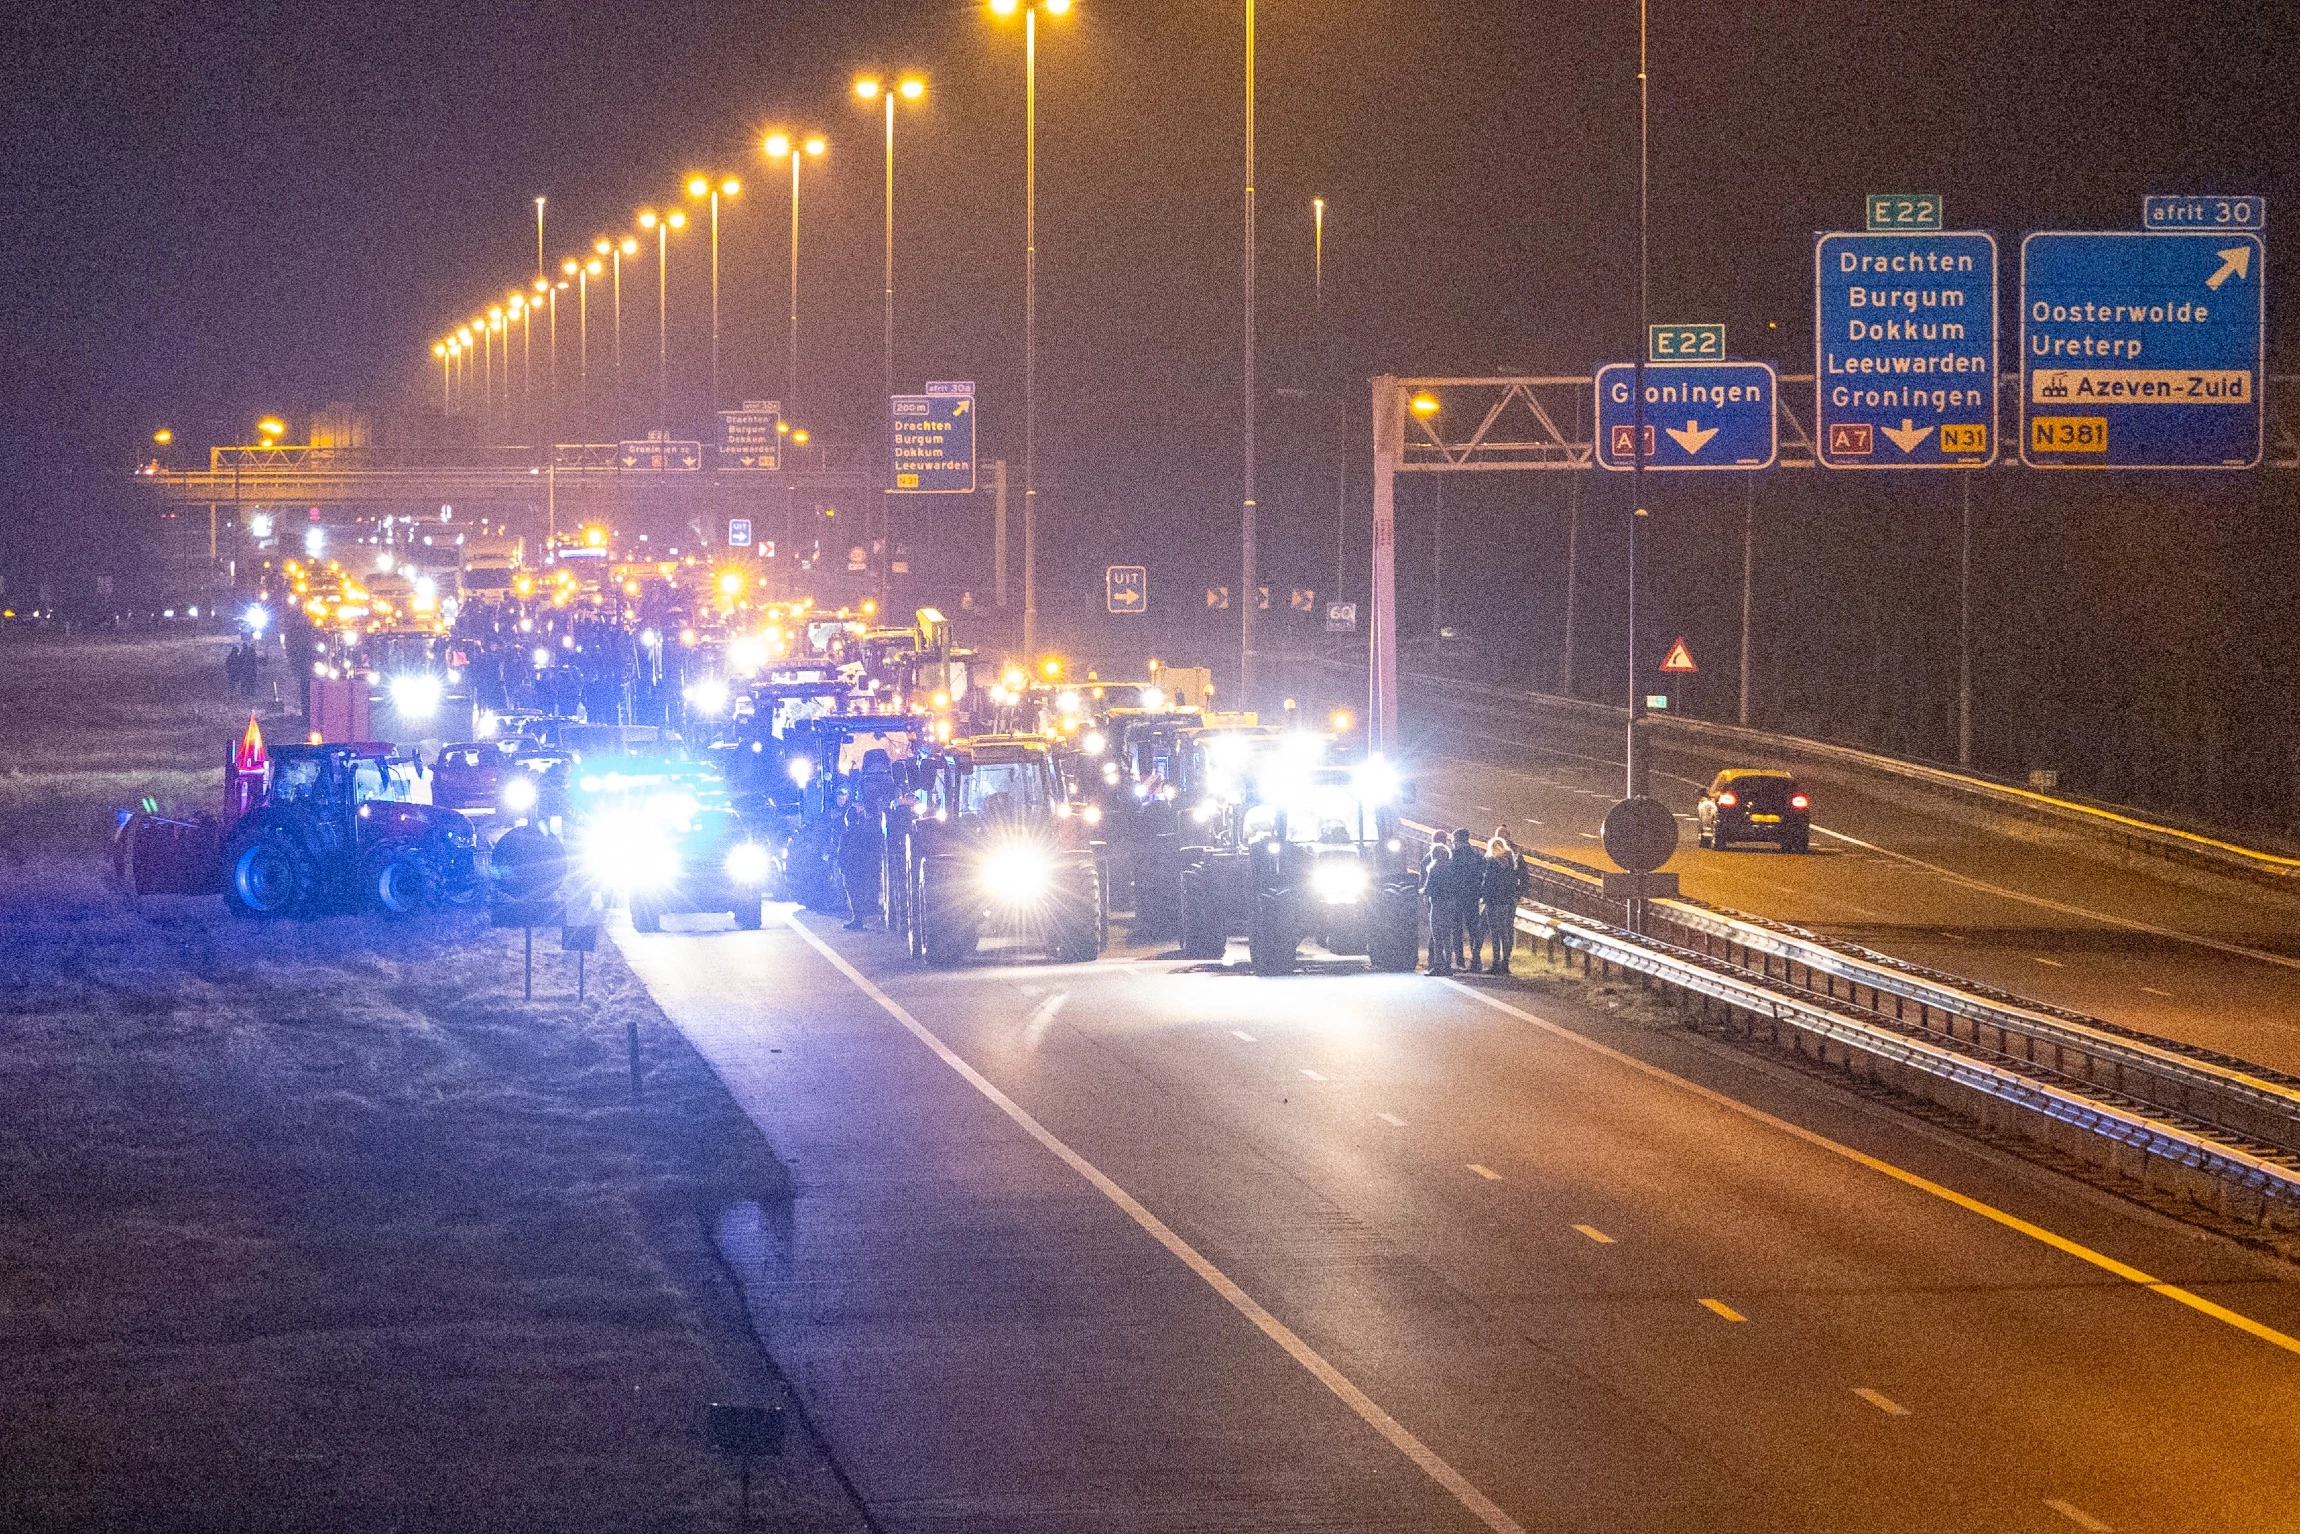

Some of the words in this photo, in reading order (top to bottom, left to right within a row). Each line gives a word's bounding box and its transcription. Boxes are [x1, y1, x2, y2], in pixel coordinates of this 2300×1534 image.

[2153, 203, 2203, 221] afrit
[2215, 201, 2251, 223] 30
[1840, 251, 1973, 273] Drachten
[1849, 286, 1965, 313] Burgum
[2032, 301, 2209, 323] Oosterwolde
[1849, 319, 1965, 340] Dokkum
[2032, 334, 2142, 360] Ureterp
[1828, 352, 1986, 374] Leeuwarden
[1611, 382, 1761, 409] Goningen
[2076, 376, 2244, 397] Azeven-Zuid
[1832, 385, 1982, 413] Groningen
[895, 421, 952, 431] Drachten
[895, 434, 944, 446] Burgum
[895, 447, 943, 457] Dokkum
[895, 460, 969, 470] Leeuwarden
[1114, 572, 1139, 584] UIT
[1329, 605, 1352, 620] 60
